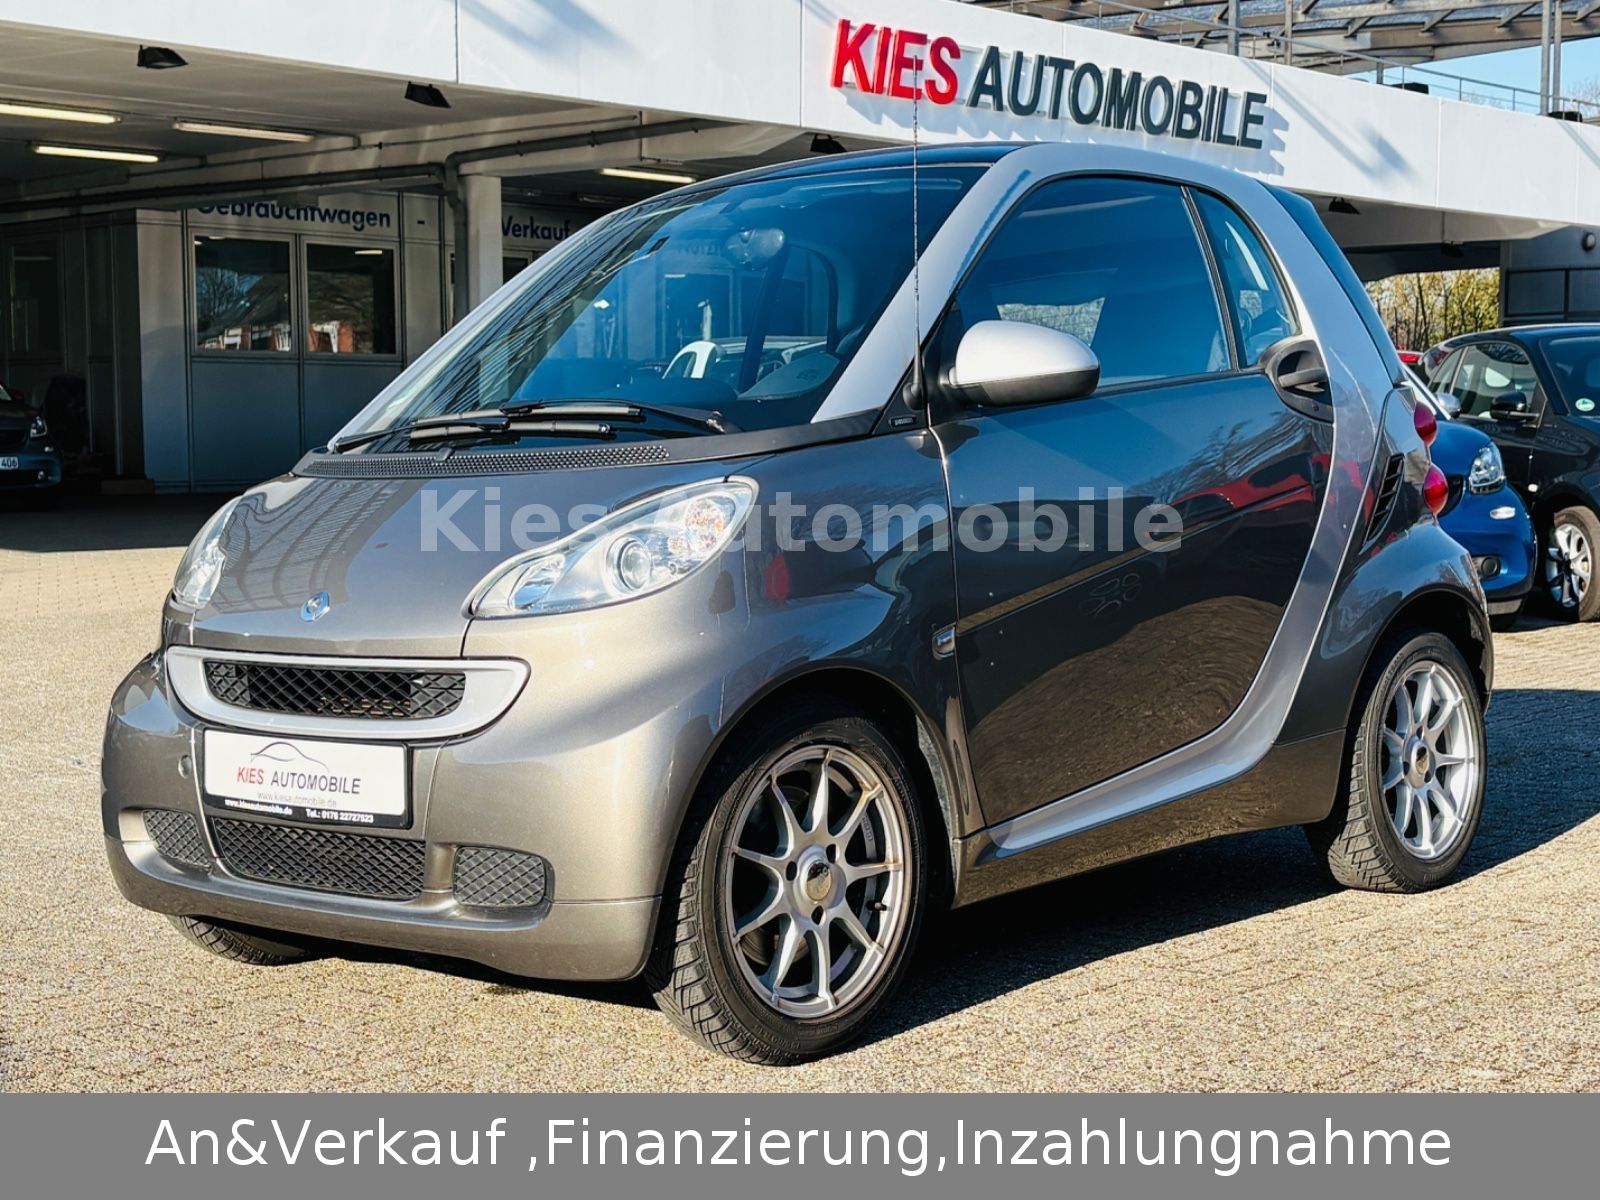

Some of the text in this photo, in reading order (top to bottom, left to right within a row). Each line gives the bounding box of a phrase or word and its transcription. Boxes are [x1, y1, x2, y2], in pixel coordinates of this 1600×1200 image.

[831, 19, 1267, 149] KIES AUTOMOBILE
[502, 215, 571, 241] Verkauf
[236, 767, 361, 795] KIES AUTOMOBILE
